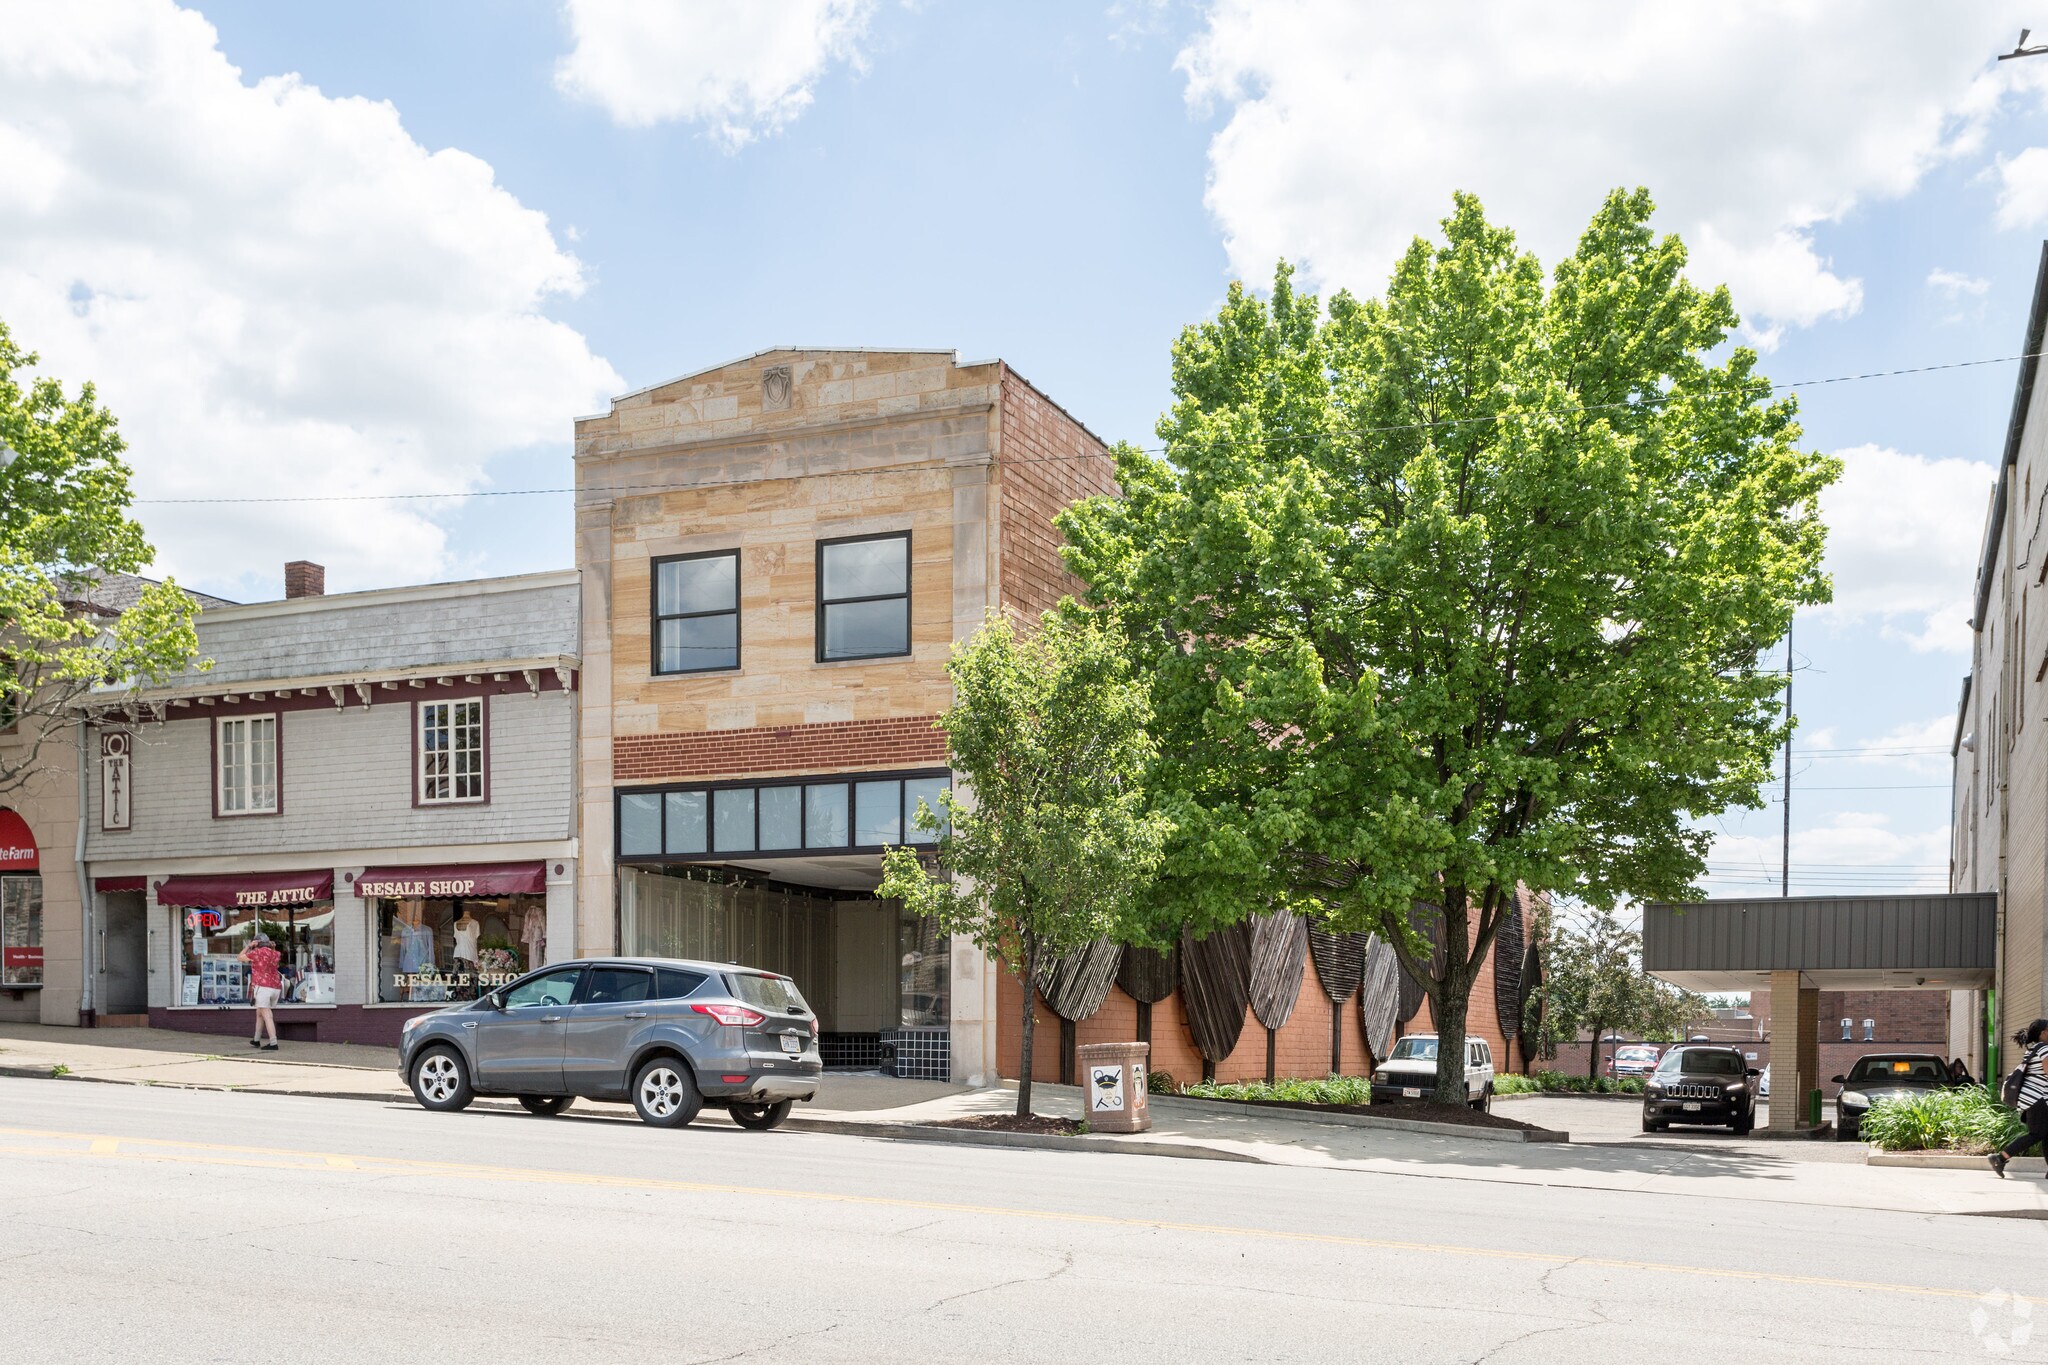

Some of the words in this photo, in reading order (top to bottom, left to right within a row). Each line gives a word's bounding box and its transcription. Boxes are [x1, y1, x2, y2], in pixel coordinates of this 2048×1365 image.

[108, 758, 123, 768] THE
[111, 766, 121, 825] ATTIC
[236, 891, 267, 905] THE
[270, 886, 315, 903] ATTIC
[361, 881, 426, 896] RESALE
[429, 880, 475, 895] SHOP
[187, 913, 219, 928] OPEN
[393, 973, 471, 987] RESALE
[478, 972, 529, 987] SHO
